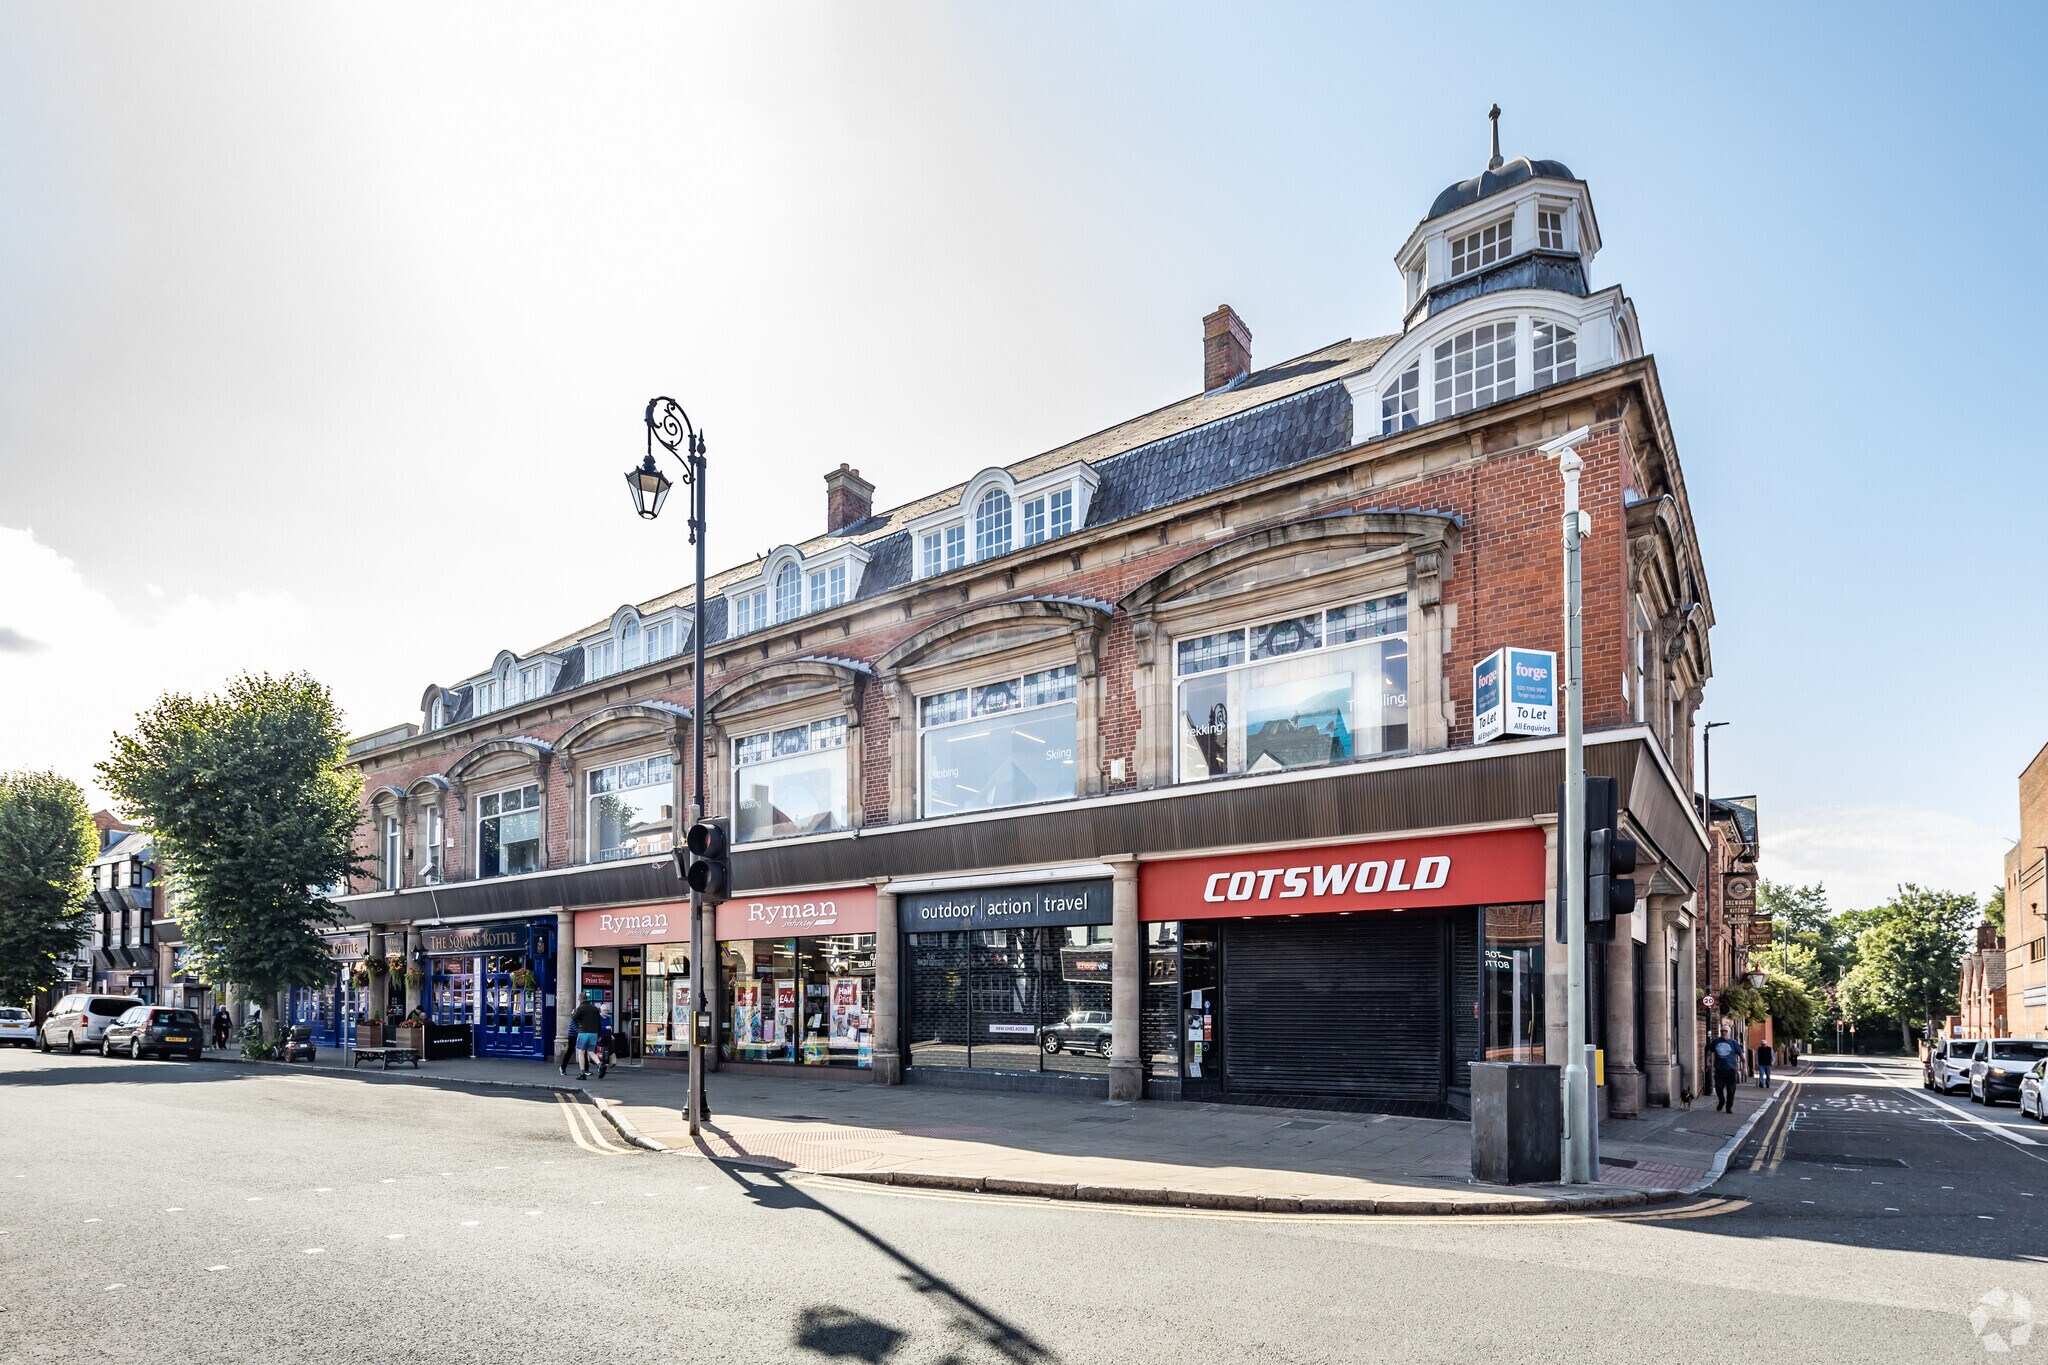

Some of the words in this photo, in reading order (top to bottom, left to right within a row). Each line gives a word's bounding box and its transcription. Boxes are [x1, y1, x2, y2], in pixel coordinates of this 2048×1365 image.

[1478, 669, 1498, 689] forge
[1515, 661, 1548, 681] forge
[1479, 717, 1486, 729] To
[1487, 711, 1497, 725] Let
[1516, 706, 1529, 719] To
[1530, 707, 1547, 720] Let
[1513, 722, 1523, 730] All
[1522, 723, 1551, 733] Enquiries
[1046, 748, 1072, 761] Skiing
[1203, 854, 1452, 903] COTSWOLD
[747, 901, 838, 925] Ryman
[921, 901, 975, 919] outdoor
[987, 898, 1032, 915] action
[1043, 892, 1088, 912] travel
[600, 913, 669, 933] Ryman
[598, 977, 611, 985] Shop
[838, 985, 853, 995] Half
[838, 996, 853, 1004] Price
